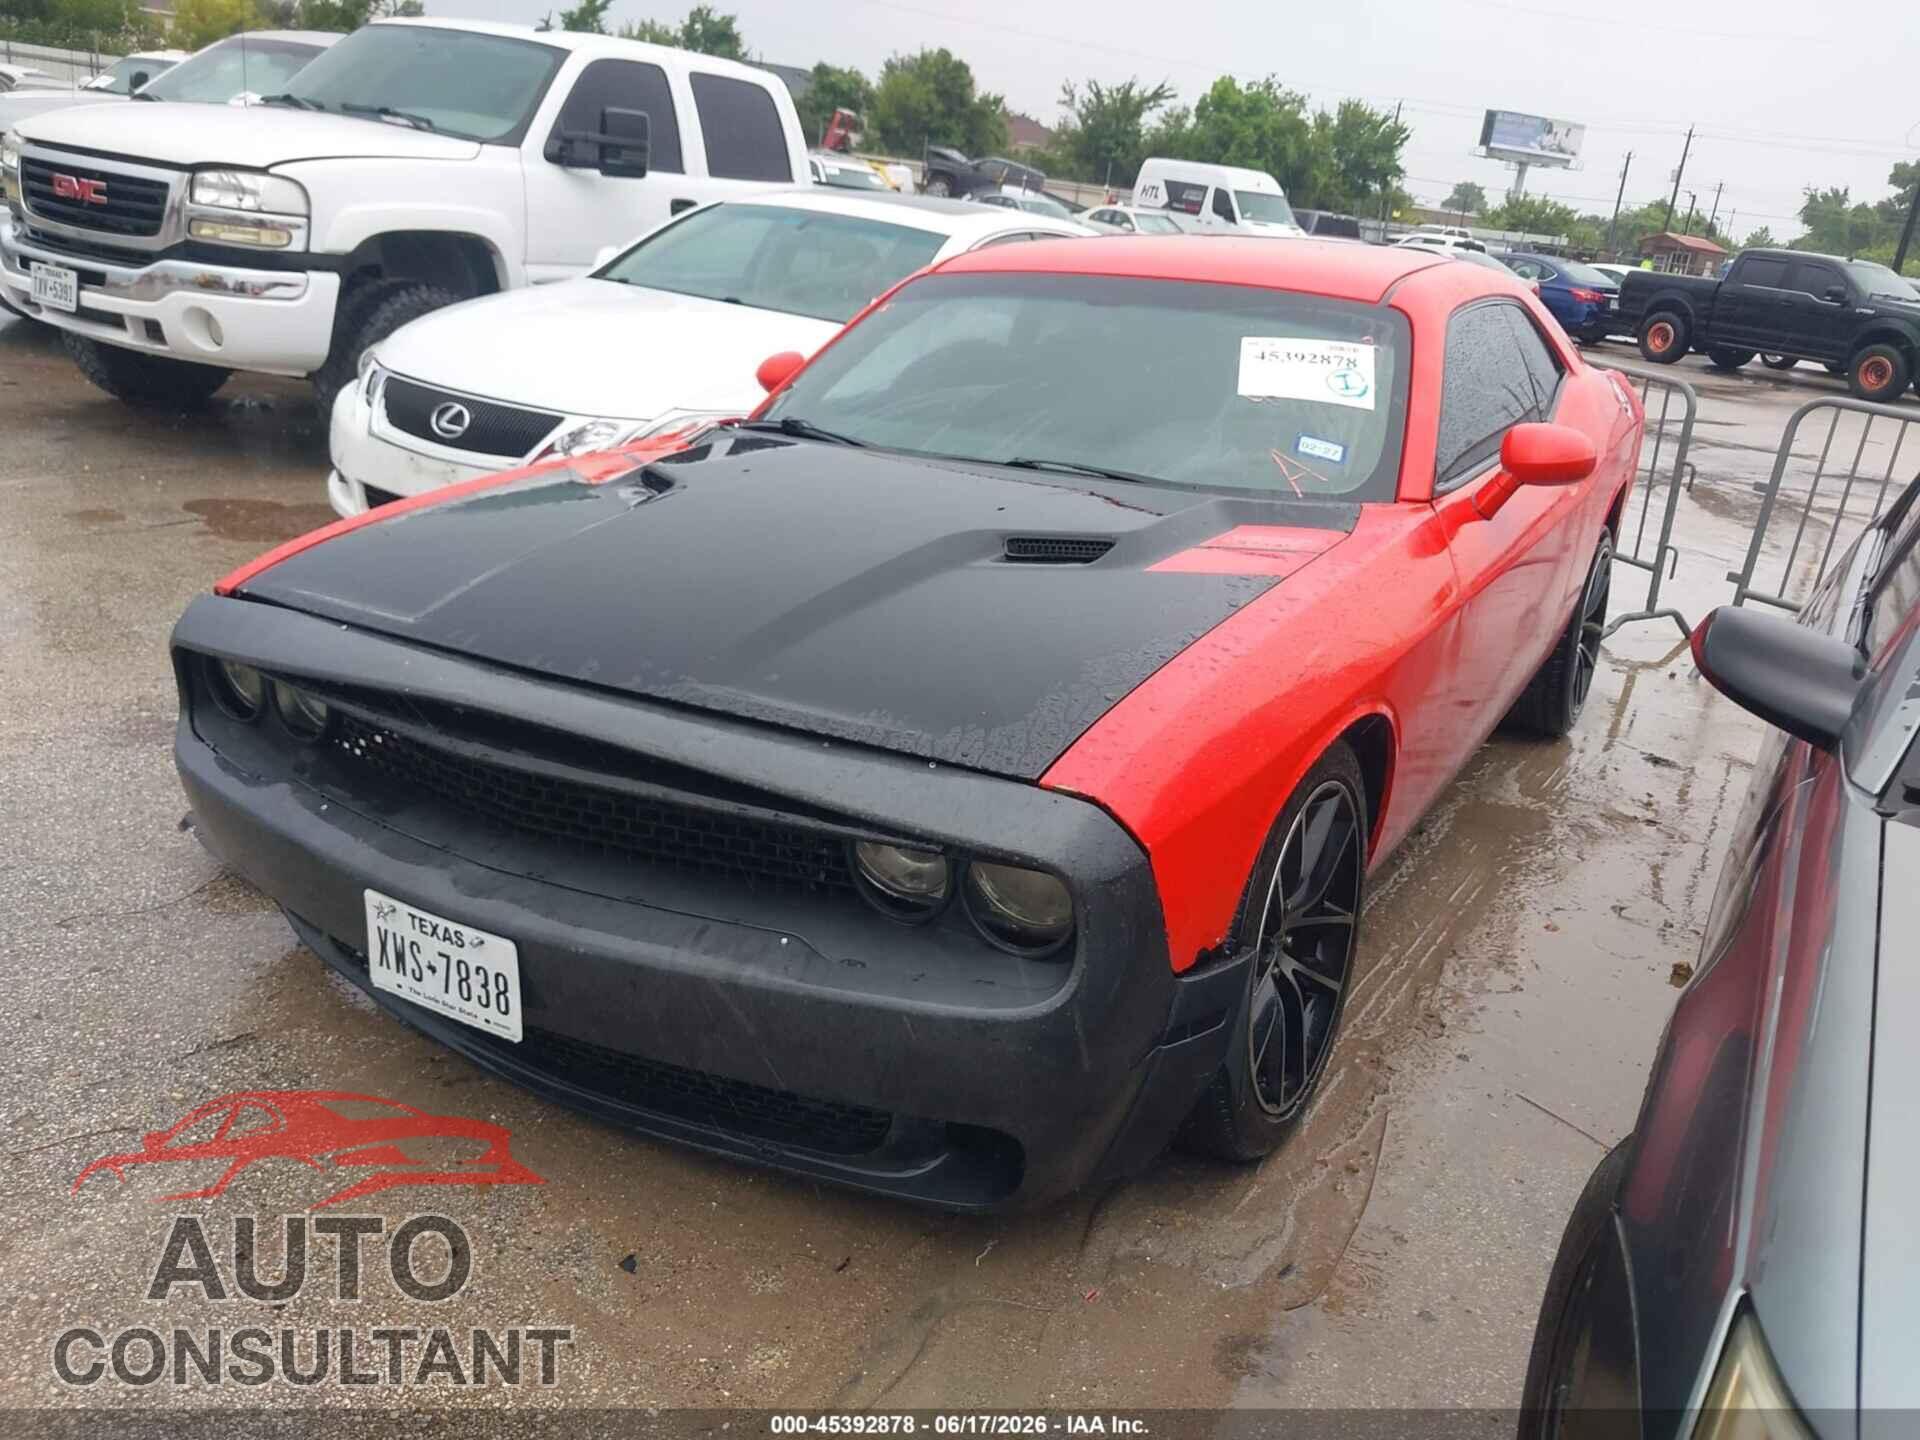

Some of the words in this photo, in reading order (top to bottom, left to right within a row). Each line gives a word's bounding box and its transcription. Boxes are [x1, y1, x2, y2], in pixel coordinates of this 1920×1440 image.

[51, 172, 108, 205] GMC
[1253, 350, 1358, 369] 45392878
[407, 912, 466, 949] TEXAS
